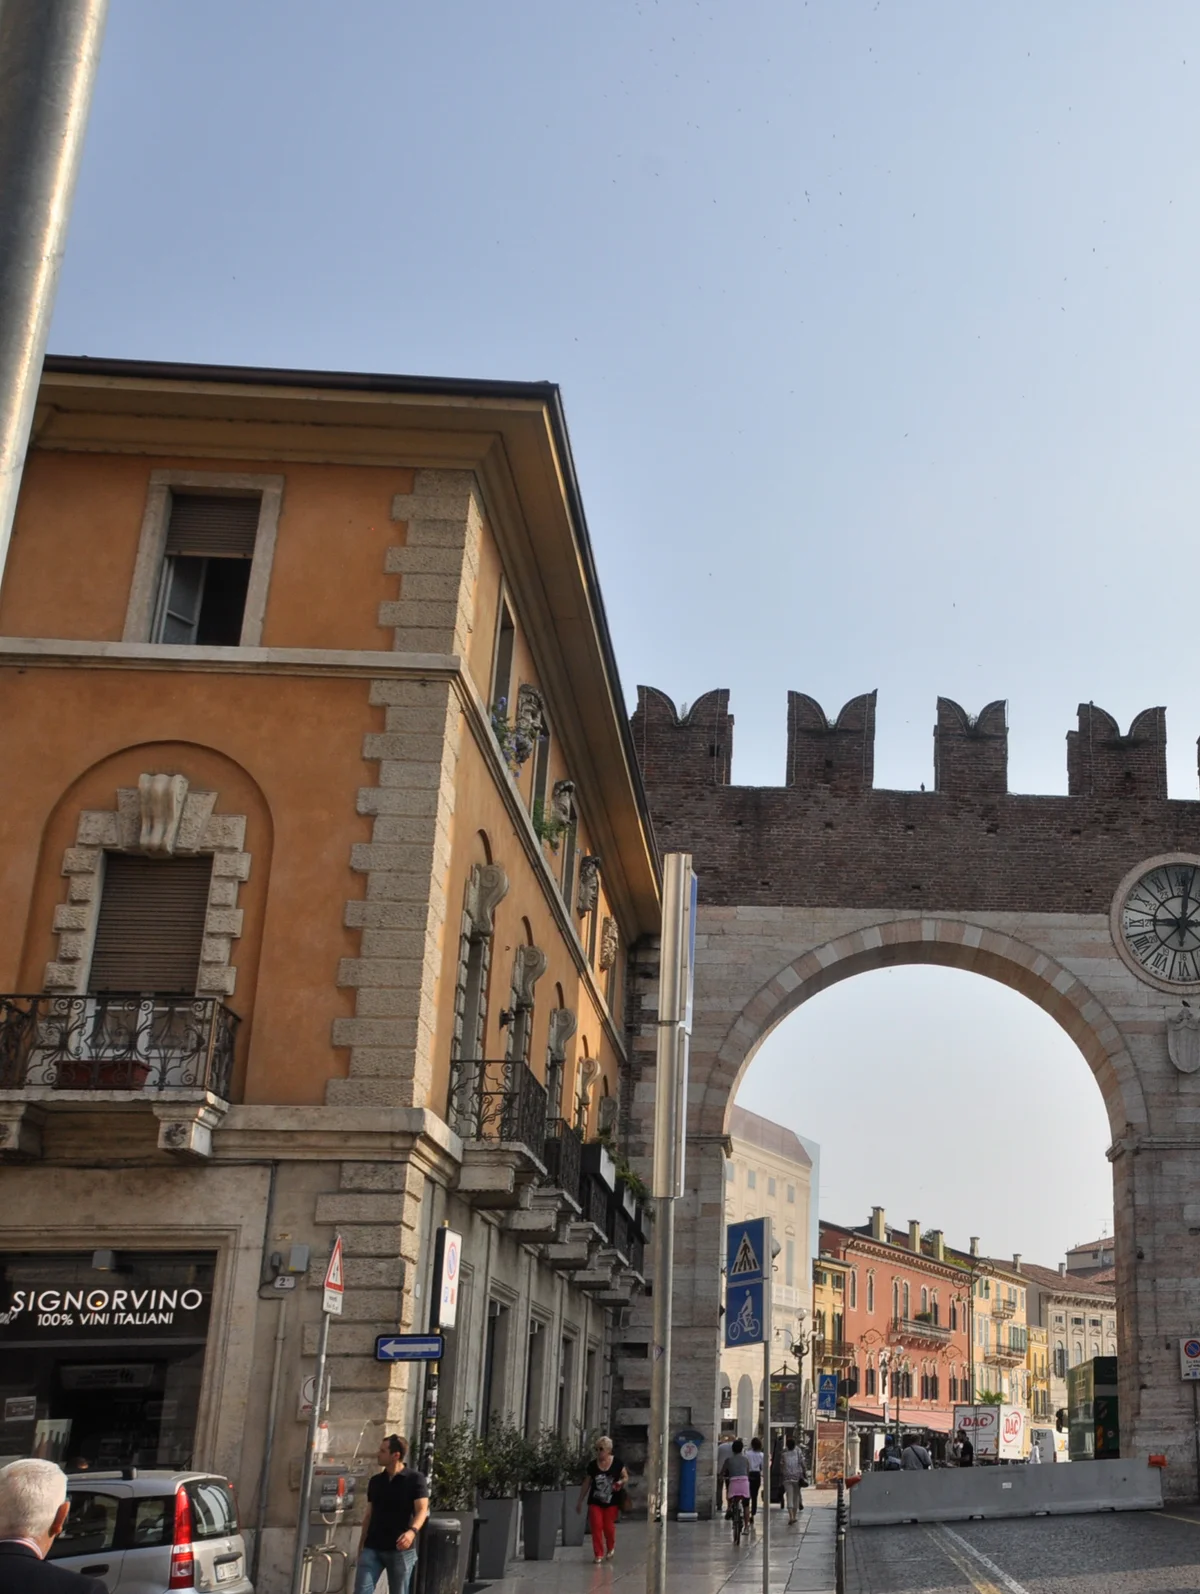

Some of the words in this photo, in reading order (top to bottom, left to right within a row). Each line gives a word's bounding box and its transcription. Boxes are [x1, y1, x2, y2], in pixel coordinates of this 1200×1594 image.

[1180, 953, 1187, 961] 18
[11, 1289, 202, 1312] SIGNORVINO
[37, 1313, 74, 1326] 100%
[80, 1312, 110, 1325] VINI
[114, 1312, 173, 1325] ITALIANI
[963, 1417, 988, 1427] DAC
[1005, 1418, 1018, 1435] DAC
